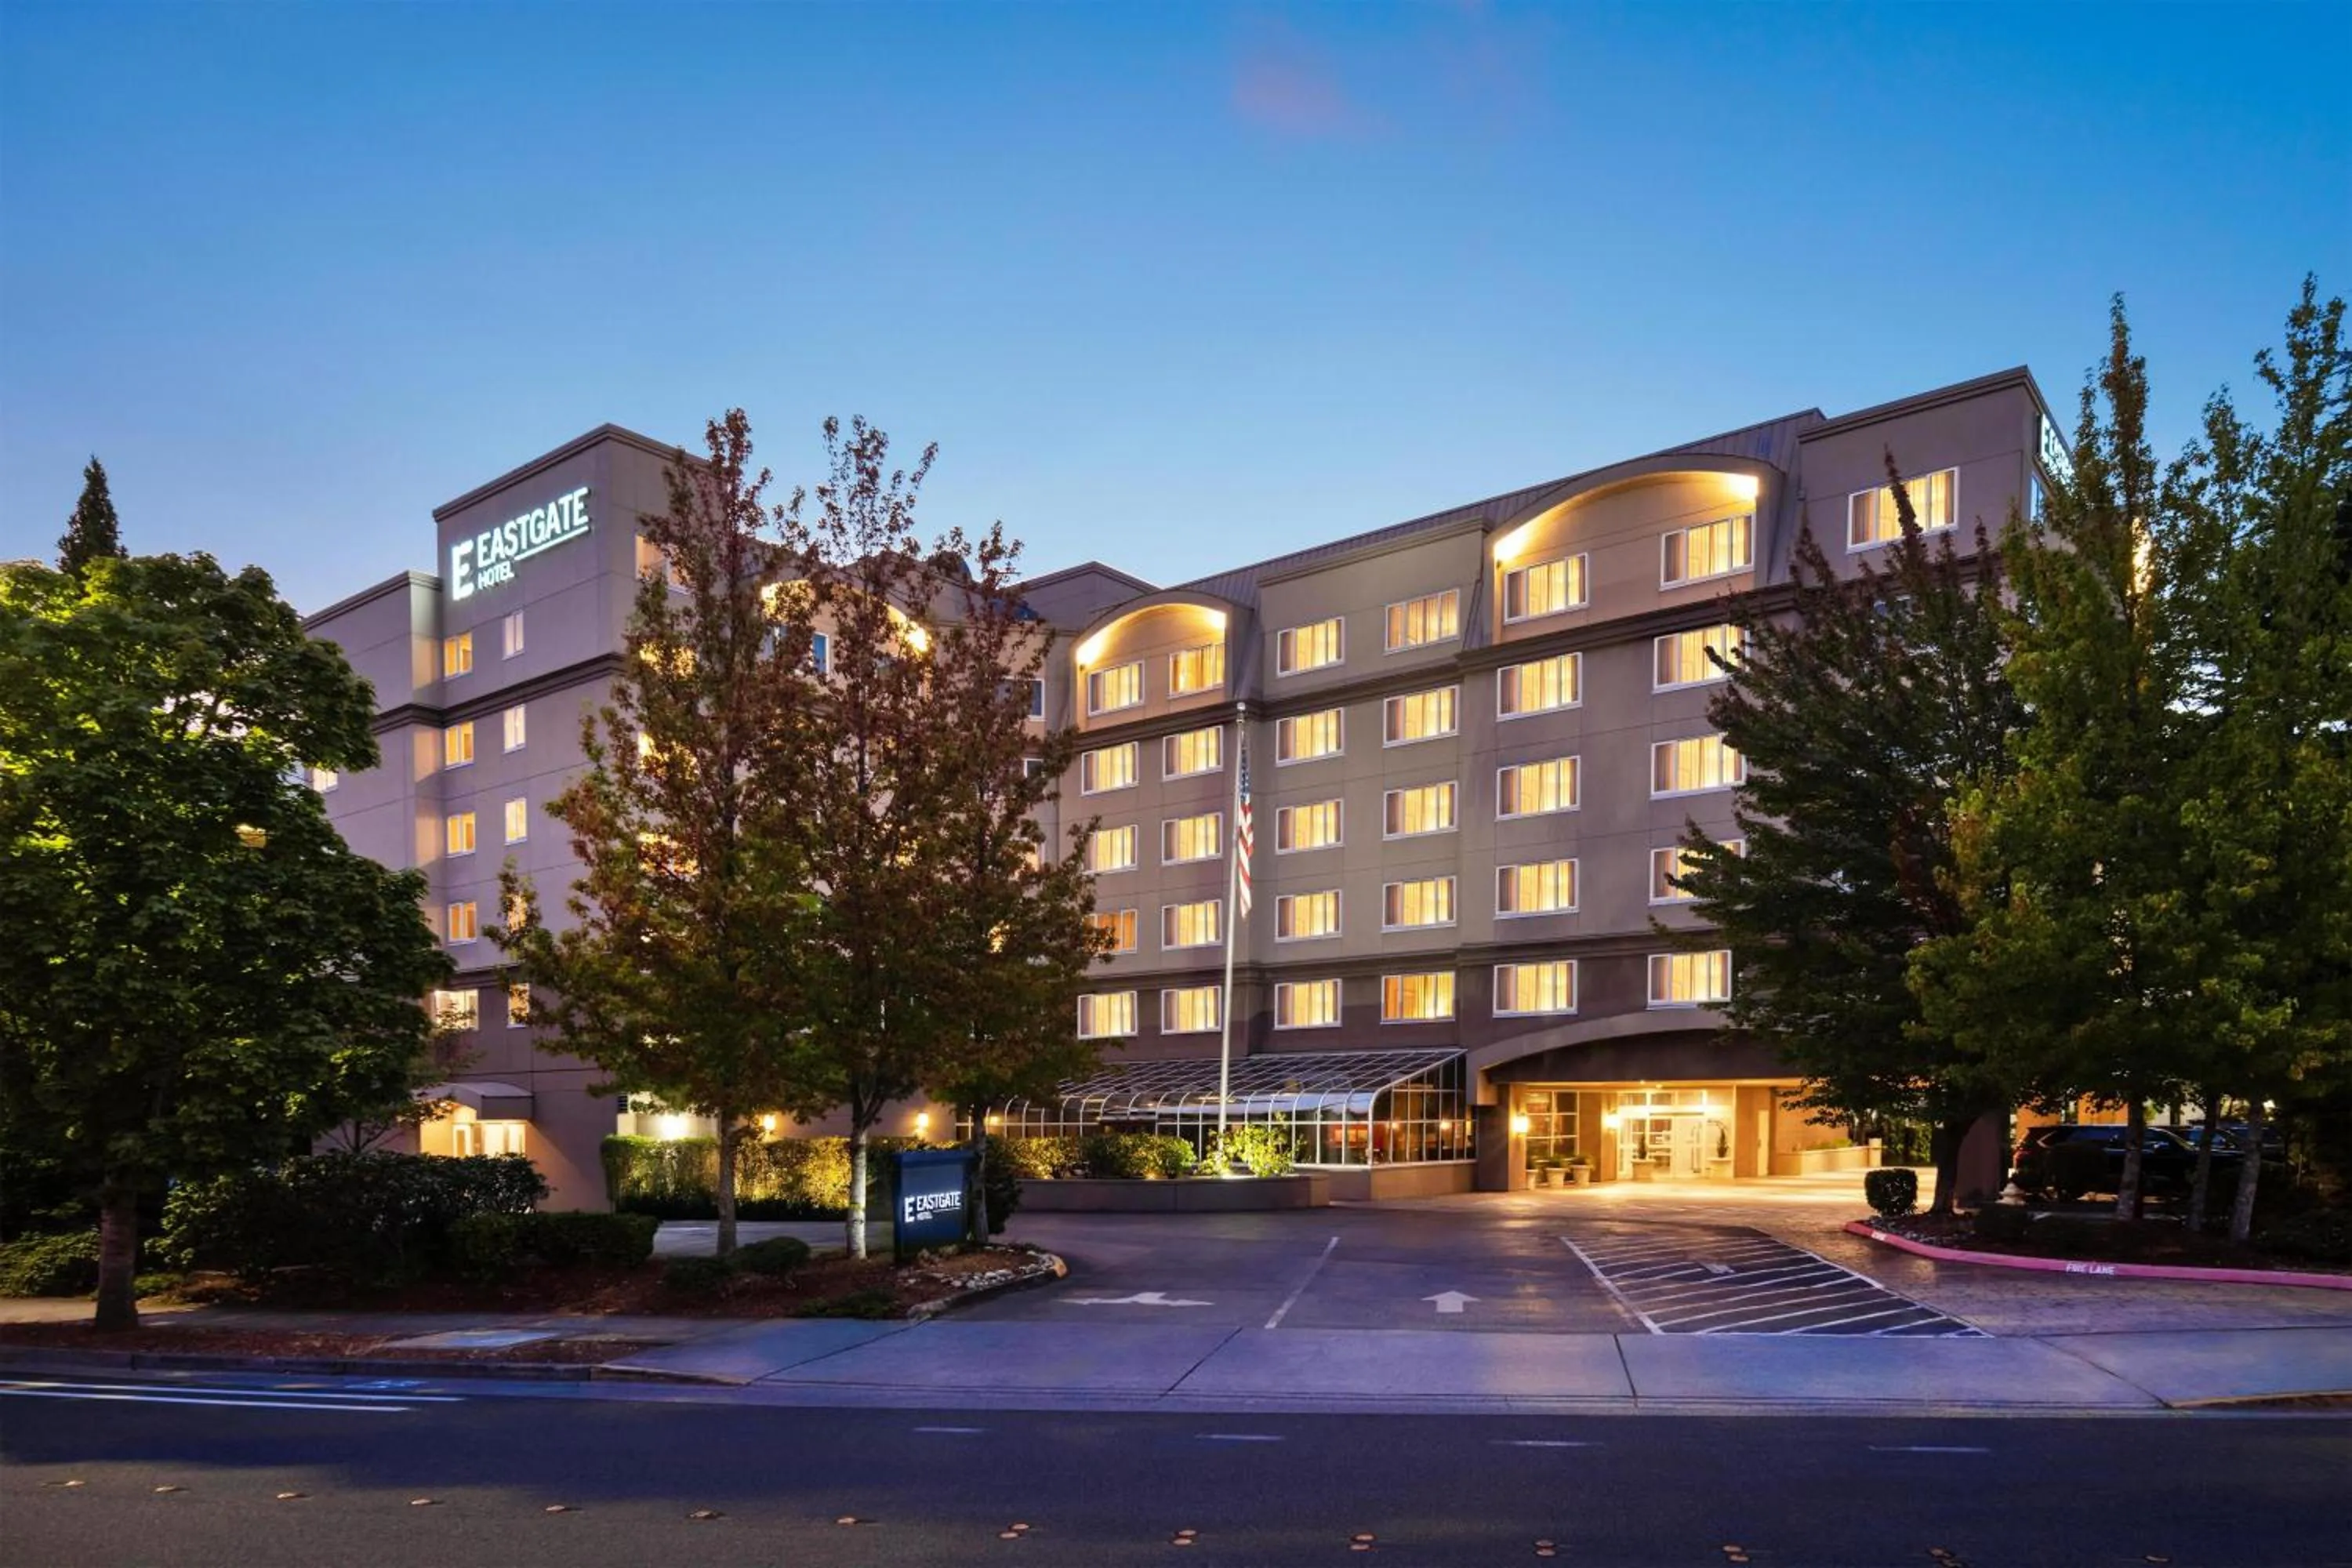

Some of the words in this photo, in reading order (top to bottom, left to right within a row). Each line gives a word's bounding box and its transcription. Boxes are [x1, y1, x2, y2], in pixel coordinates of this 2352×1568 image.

[452, 540, 474, 601] E
[477, 487, 589, 567] EASTGATE
[478, 561, 514, 590] HOTEL
[905, 1197, 915, 1222] E
[916, 1191, 961, 1211] EASTGATE
